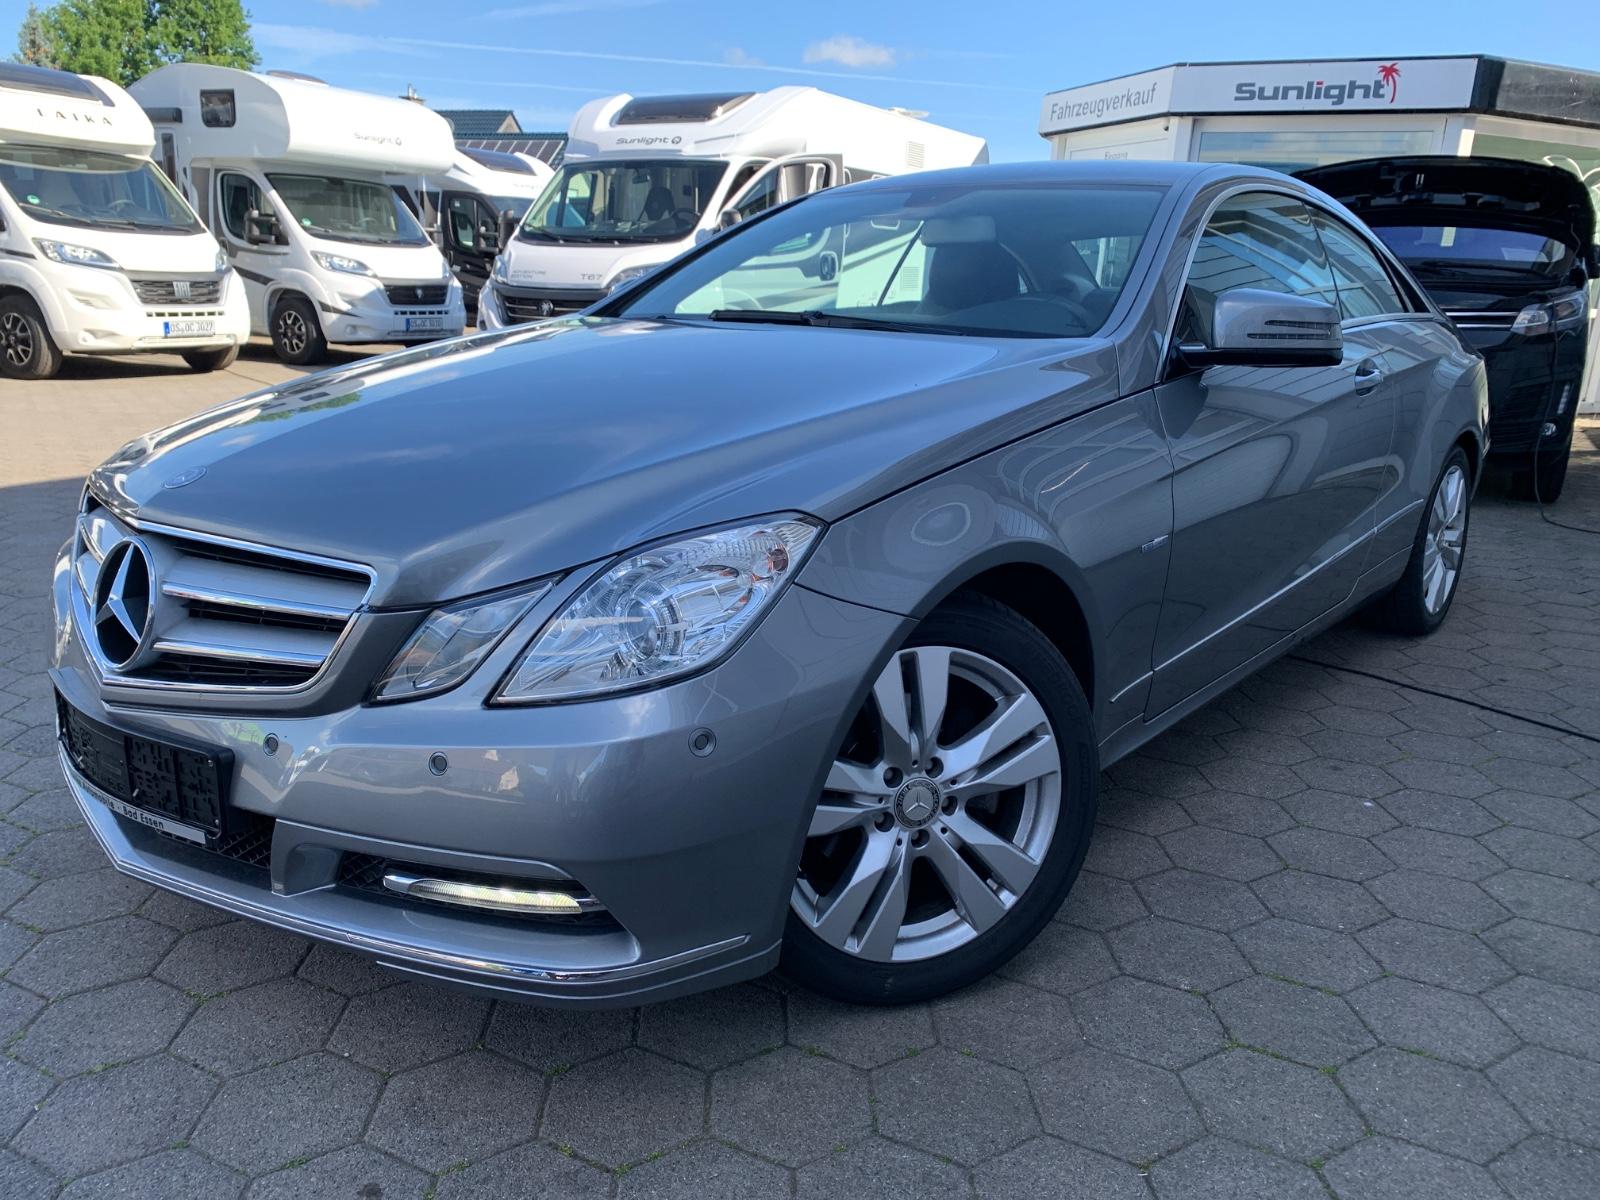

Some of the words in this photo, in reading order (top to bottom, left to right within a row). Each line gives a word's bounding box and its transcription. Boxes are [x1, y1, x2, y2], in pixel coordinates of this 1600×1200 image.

[1050, 82, 1157, 120] Fahrzeugverkauf
[1234, 80, 1386, 105] Sunlight
[615, 136, 670, 146] Sunlight
[122, 806, 137, 820] Bad
[140, 813, 164, 829] Essen
